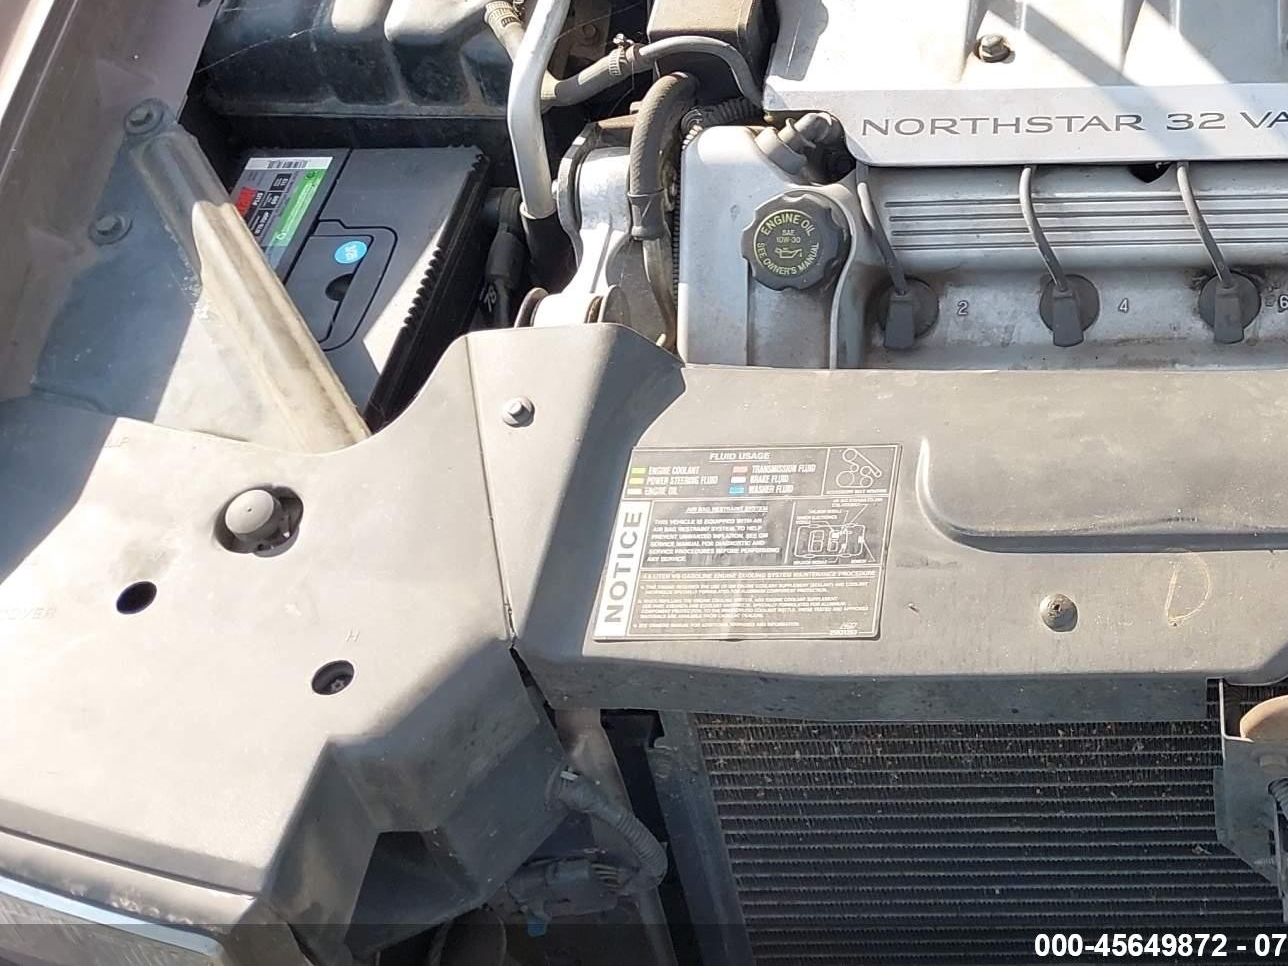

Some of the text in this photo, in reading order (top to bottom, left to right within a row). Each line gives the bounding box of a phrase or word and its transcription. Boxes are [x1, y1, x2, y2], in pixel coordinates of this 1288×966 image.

[861, 114, 1147, 135] NORTHSTAR
[1166, 113, 1227, 131] 32
[760, 213, 817, 237] ENGINE OIL
[757, 242, 820, 275] SEE OWNER'S MANUAL
[957, 300, 970, 316] 2
[1119, 299, 1130, 314] 4
[709, 452, 772, 461] FLUID USAGE
[648, 465, 700, 475] ENGINE COOLANT
[752, 463, 817, 475] TRANSMISSION FLUID
[700, 475, 718, 484] FLUID
[604, 512, 643, 623] NOTICE
